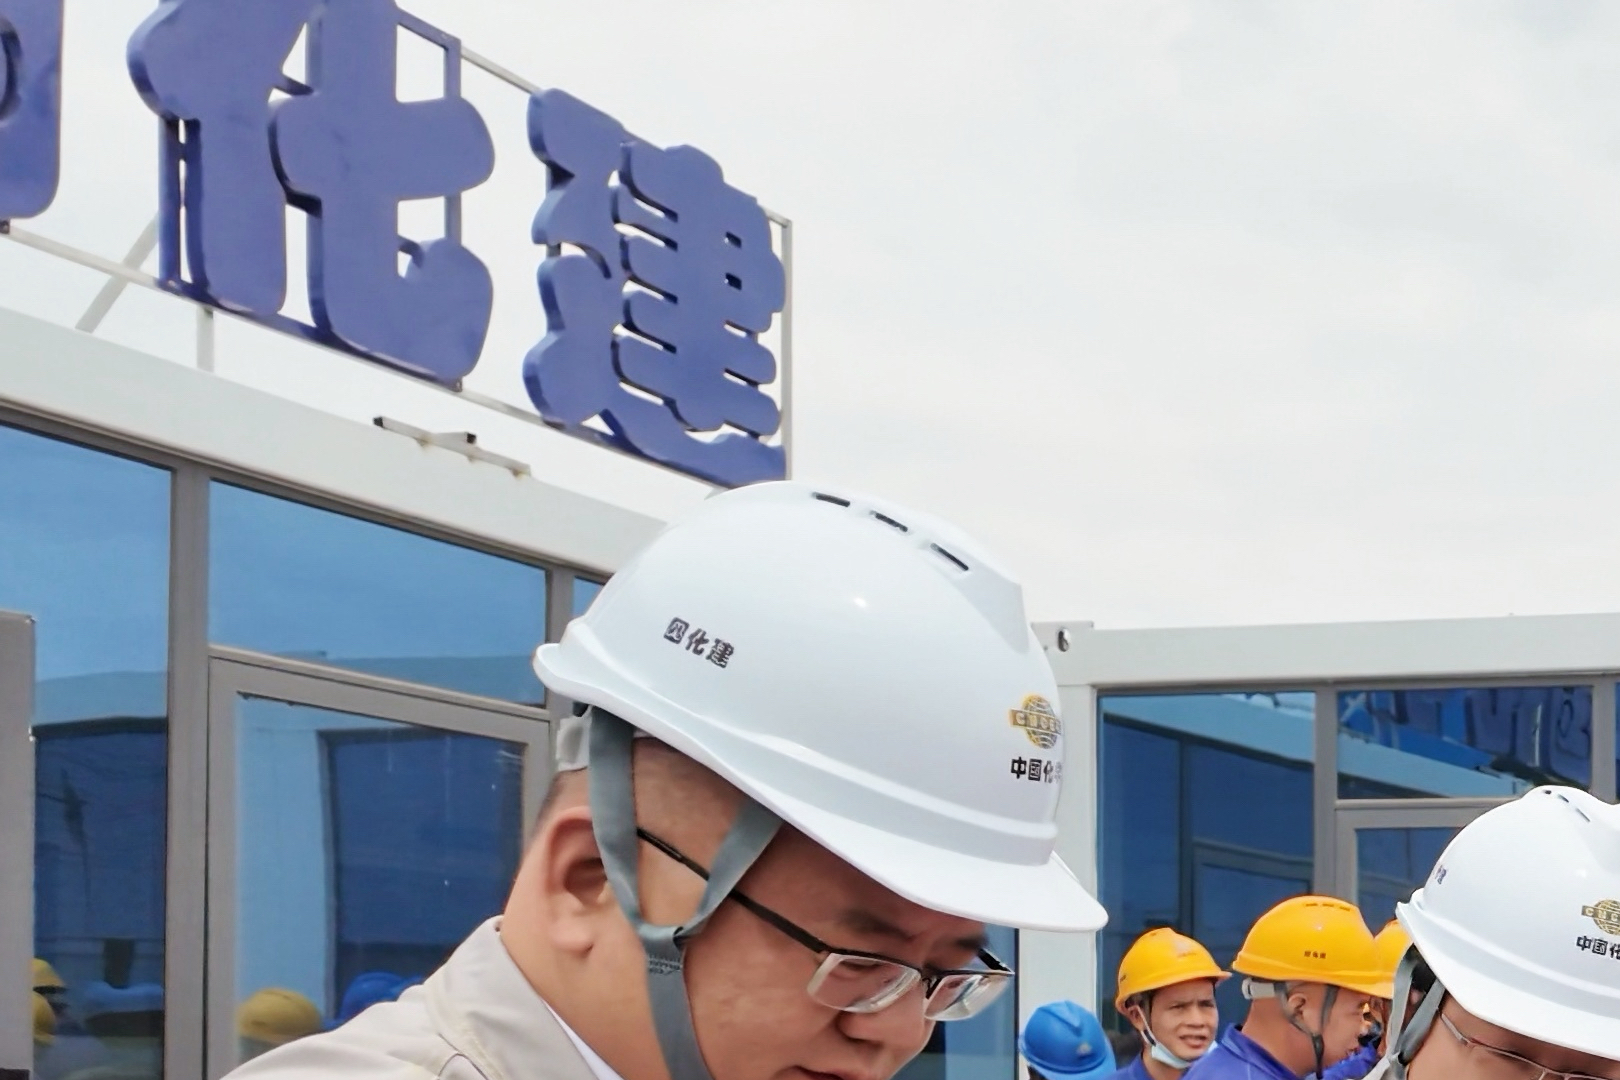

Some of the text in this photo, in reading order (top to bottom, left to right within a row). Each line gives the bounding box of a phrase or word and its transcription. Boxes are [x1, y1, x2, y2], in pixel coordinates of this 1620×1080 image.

[0, 0, 788, 487] 化建
[664, 617, 734, 668] 四化建
